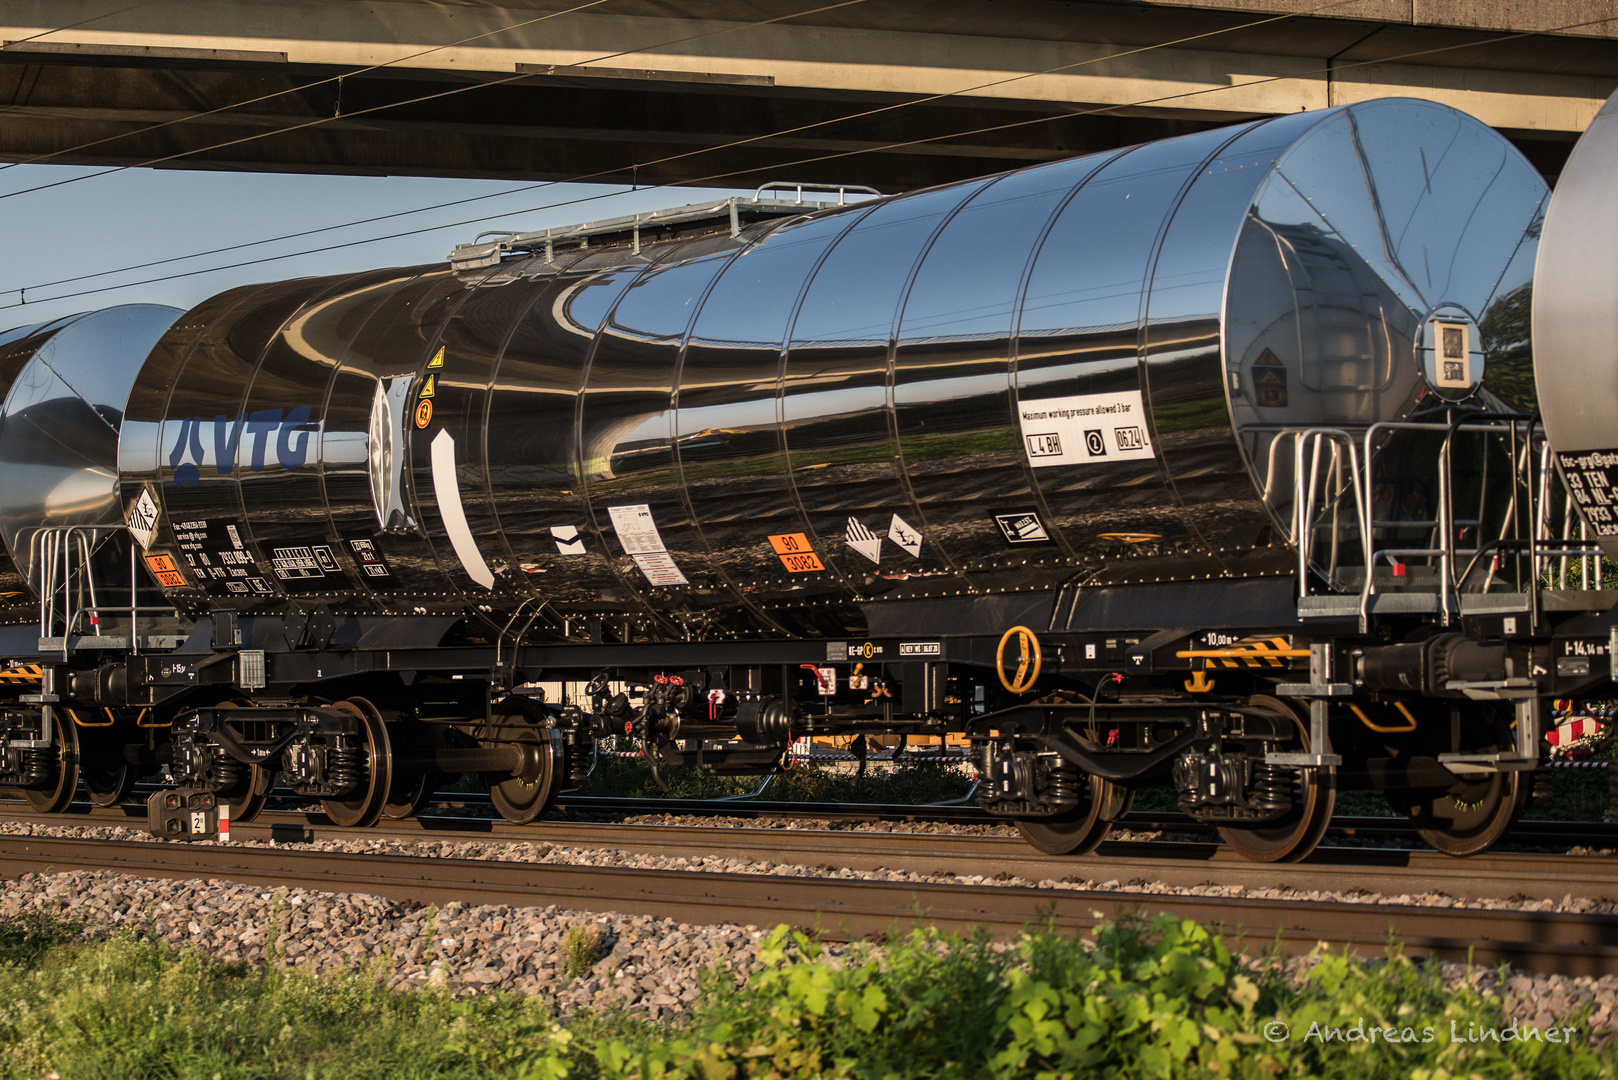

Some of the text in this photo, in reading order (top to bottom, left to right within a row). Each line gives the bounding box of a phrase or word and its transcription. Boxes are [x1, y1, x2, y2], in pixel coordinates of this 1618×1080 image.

[1022, 403, 1131, 421] Maximum working pressure allowed 3 bar
[214, 406, 311, 474] VTG
[1028, 436, 1061, 454] L 4 BH
[1092, 436, 1098, 450] 2
[1117, 429, 1149, 447] 06.24 L
[1566, 470, 1609, 488] 33 TEN
[1574, 489, 1591, 504] 84
[1583, 506, 1612, 521] 7933
[782, 536, 798, 550] 90
[155, 558, 166, 569] 90
[185, 554, 196, 566] 37
[199, 553, 211, 565] 80
[218, 552, 236, 564] 7933
[787, 556, 818, 570] 3082
[161, 573, 181, 585] 3082
[193, 568, 207, 578] TEN
[227, 567, 248, 577] Zacens
[194, 818, 200, 829] 2
